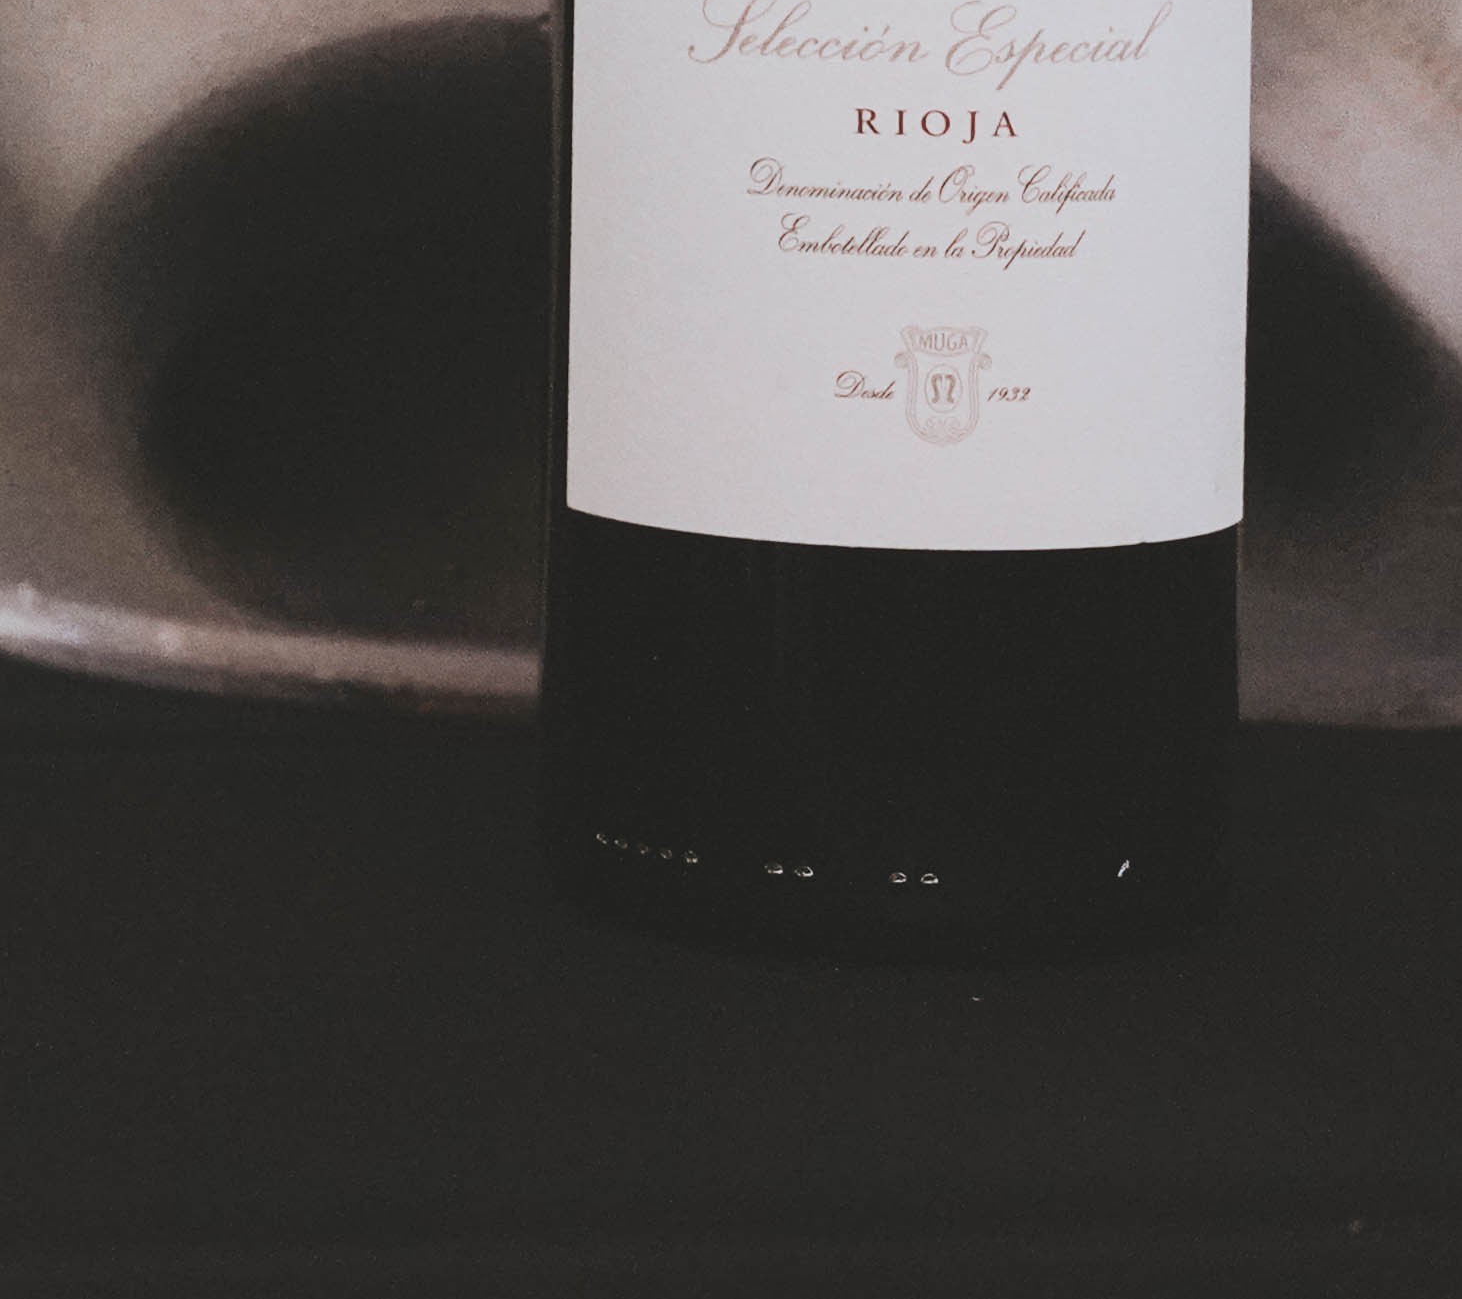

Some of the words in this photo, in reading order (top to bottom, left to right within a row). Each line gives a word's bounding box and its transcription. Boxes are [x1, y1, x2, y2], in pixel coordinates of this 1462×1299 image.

[945, 0, 1173, 92] Especial
[855, 107, 1020, 145] RIOJA
[746, 156, 904, 205] Denominación
[908, 174, 934, 205] de
[938, 163, 1010, 217] Origen
[1016, 163, 1117, 217] Calificada
[778, 212, 910, 260] Embotellado
[912, 236, 938, 260] en
[943, 226, 965, 260] la
[970, 220, 1087, 272] Propiedad
[919, 331, 969, 352] MUGA
[833, 369, 897, 402] Desde
[987, 386, 1032, 403] 1932
